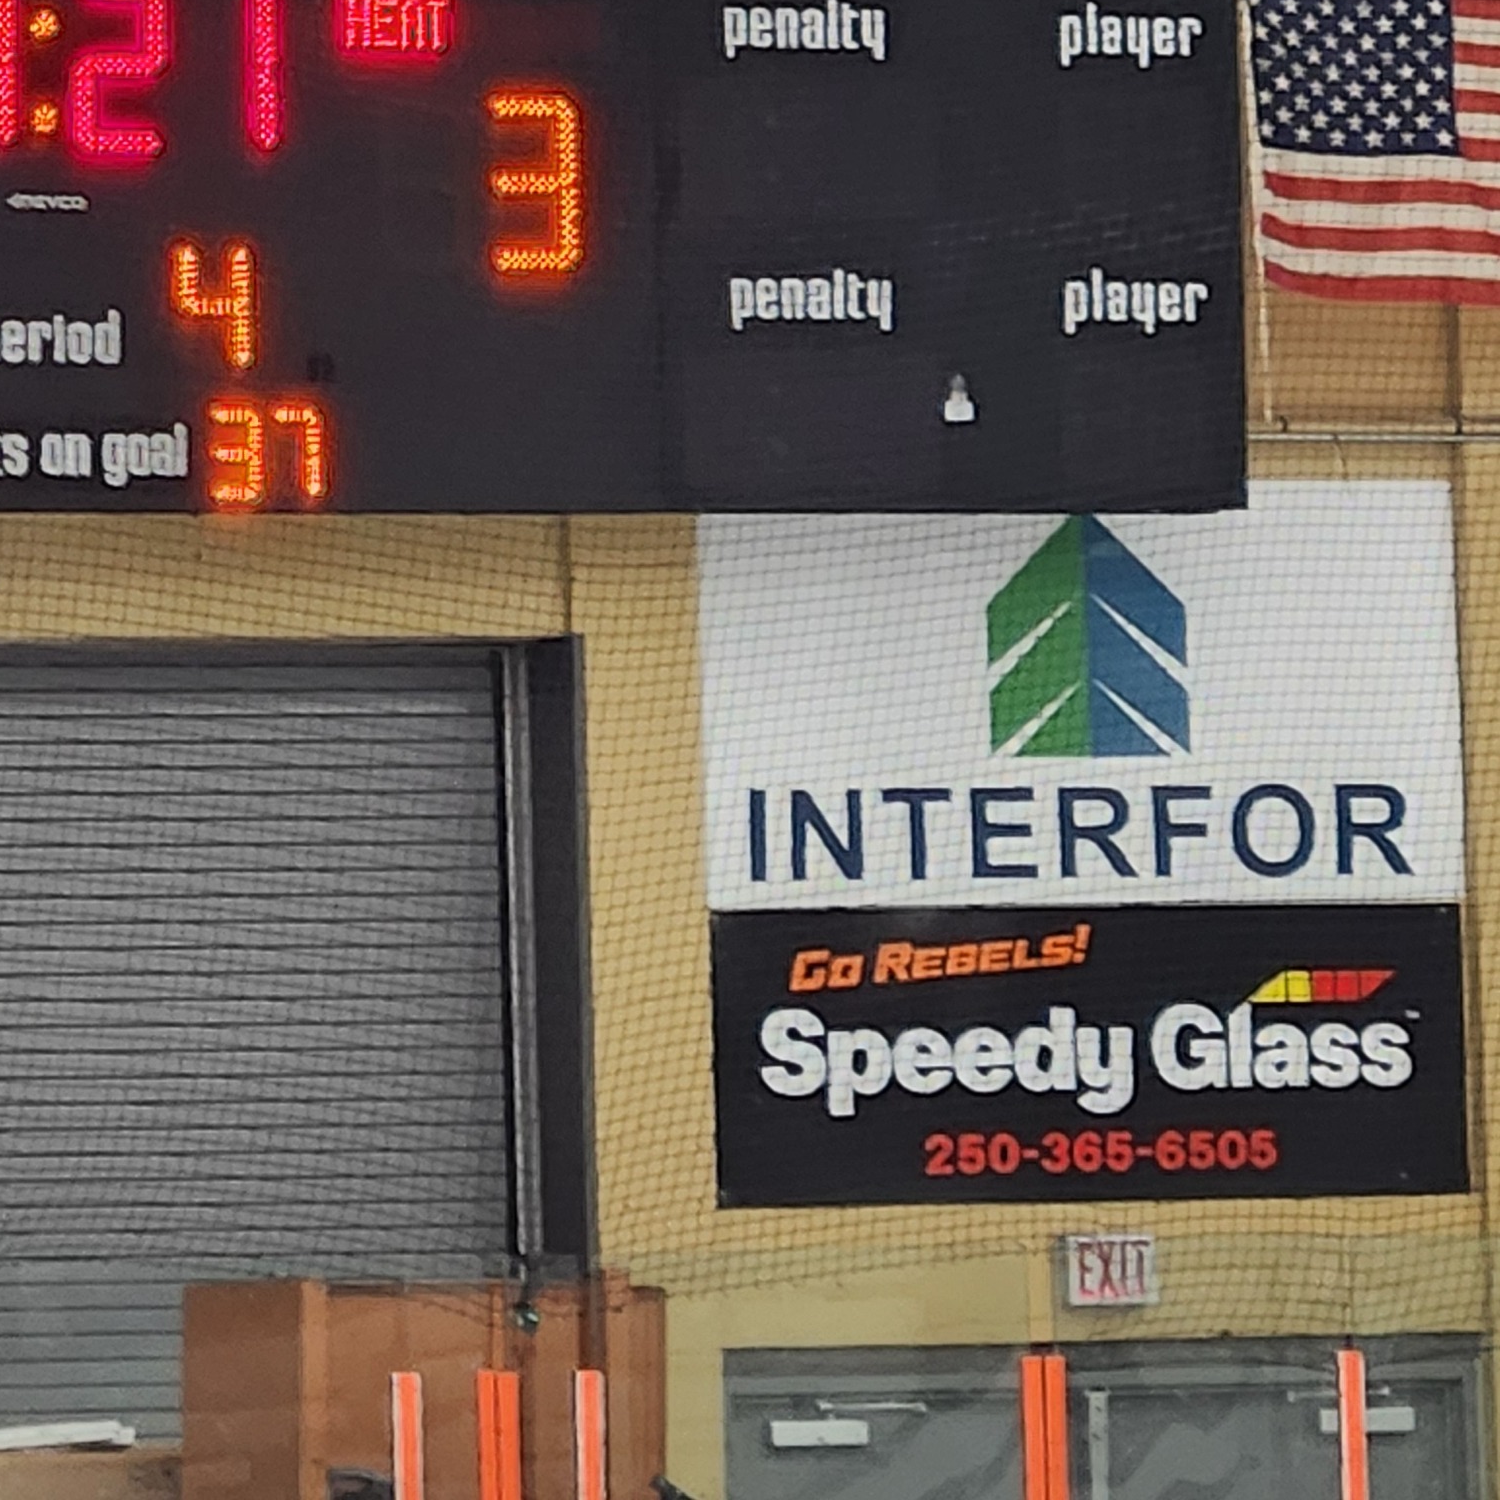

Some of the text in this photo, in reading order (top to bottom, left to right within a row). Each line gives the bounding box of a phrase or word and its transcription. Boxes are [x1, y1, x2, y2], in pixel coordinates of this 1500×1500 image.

[1059, 1, 1202, 69] player
[489, 93, 583, 274] 3
[174, 242, 255, 368] 4
[730, 268, 893, 332] penalty
[1063, 267, 1209, 335] player
[40, 432, 92, 476] on
[102, 424, 189, 486] goal
[211, 402, 327, 502] 37
[747, 783, 1414, 882] INTERFOR
[760, 1000, 1412, 1117] Speedy Glass
[924, 1131, 1278, 1176] 250-365-6505
[1076, 1239, 1150, 1298] EXIT
